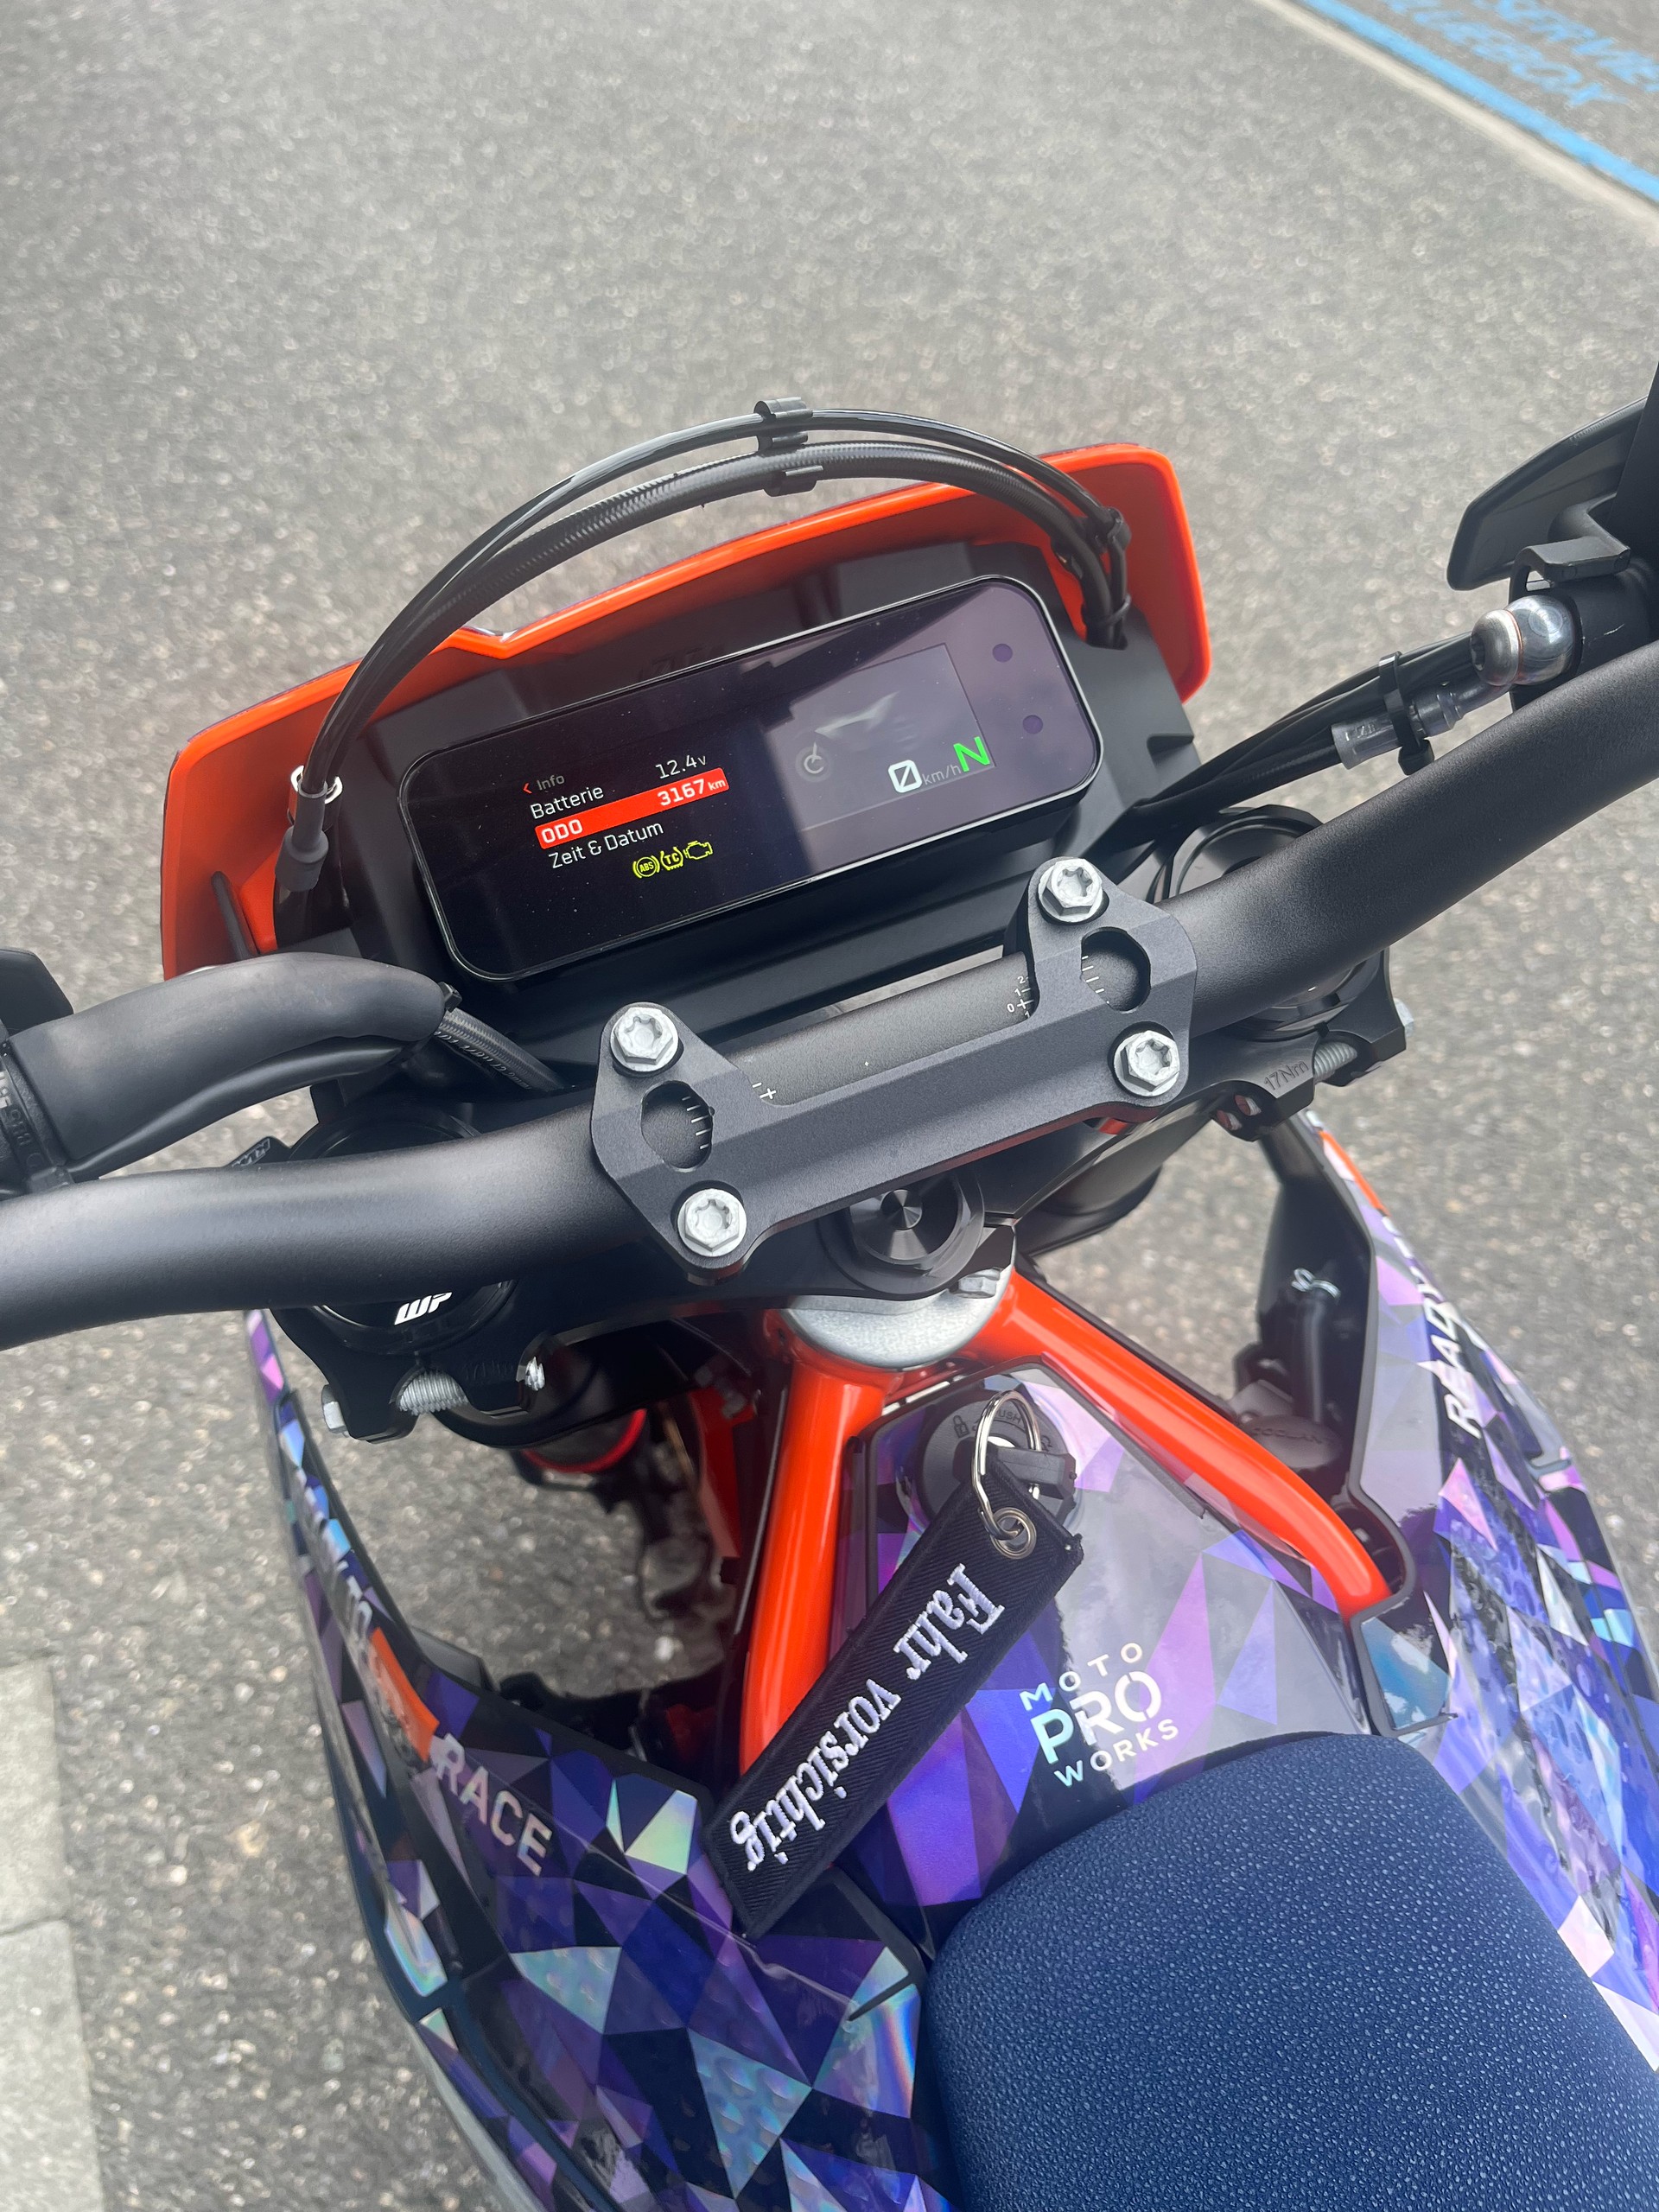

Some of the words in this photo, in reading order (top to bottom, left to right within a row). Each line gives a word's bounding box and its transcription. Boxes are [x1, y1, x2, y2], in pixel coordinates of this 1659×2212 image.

[953, 736, 990, 772] N
[537, 775, 565, 791] Info
[922, 764, 962, 785] km/h
[530, 786, 604, 819] Batterie
[541, 818, 583, 844] ODO
[658, 779, 705, 806] 3167
[708, 779, 726, 791] km
[548, 845, 587, 869] Zeit
[588, 841, 602, 855] &
[604, 823, 664, 851] Datum
[664, 854, 680, 865] TC
[639, 861, 655, 873] ABS
[1014, 988, 1021, 996] 1
[1017, 976, 1026, 984] 2
[1007, 1003, 1015, 1013] 0
[1263, 1059, 1310, 1092] 17Nm
[394, 1292, 453, 1325] WP
[995, 1408, 1021, 1423] USH
[893, 1562, 1005, 1681] Fahr
[1019, 1643, 1143, 1713] MOTO
[1029, 1671, 1162, 1765] PRO
[1054, 1718, 1179, 1789] WORKS
[728, 1678, 902, 1872] vorsichtig
[433, 1732, 552, 1877] RACE
